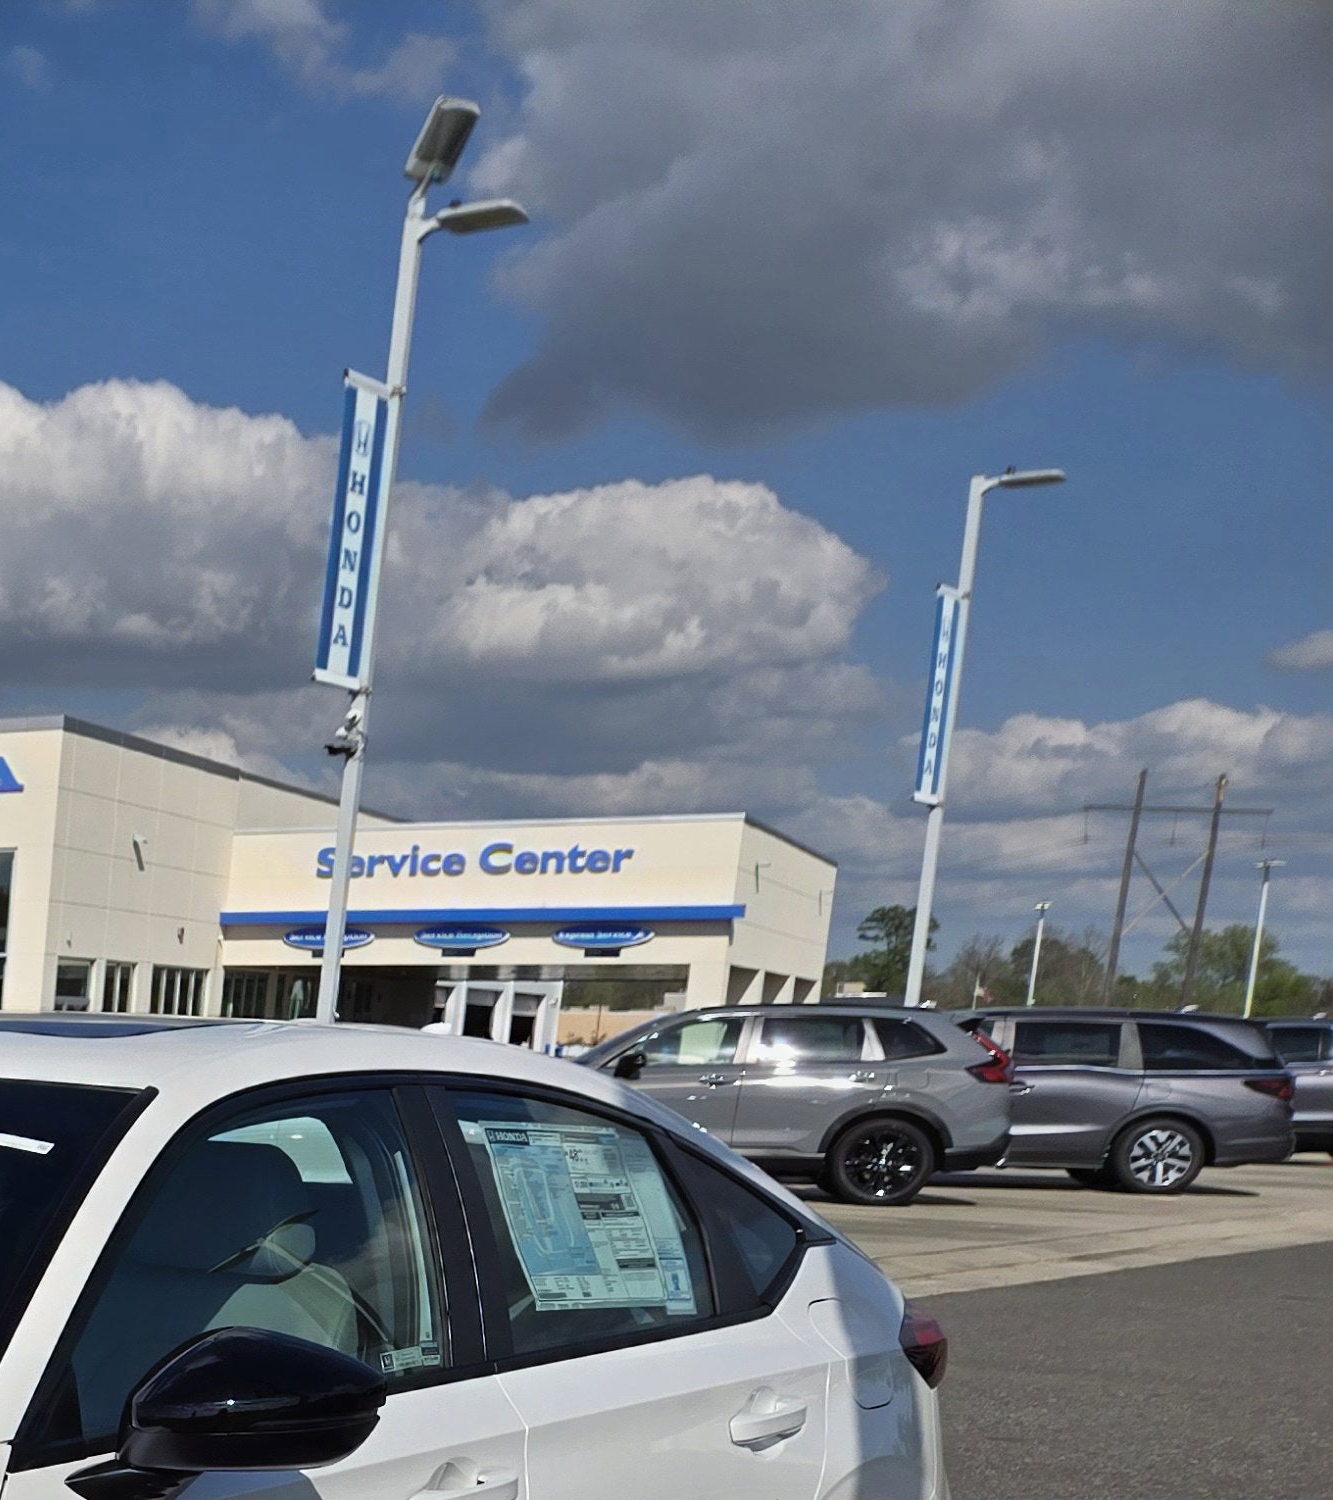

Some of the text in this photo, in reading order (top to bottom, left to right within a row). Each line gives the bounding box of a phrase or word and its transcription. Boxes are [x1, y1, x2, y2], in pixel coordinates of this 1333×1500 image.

[332, 470, 366, 646] HONDA
[316, 842, 635, 879] Service Center
[495, 1131, 528, 1142] HONDA
